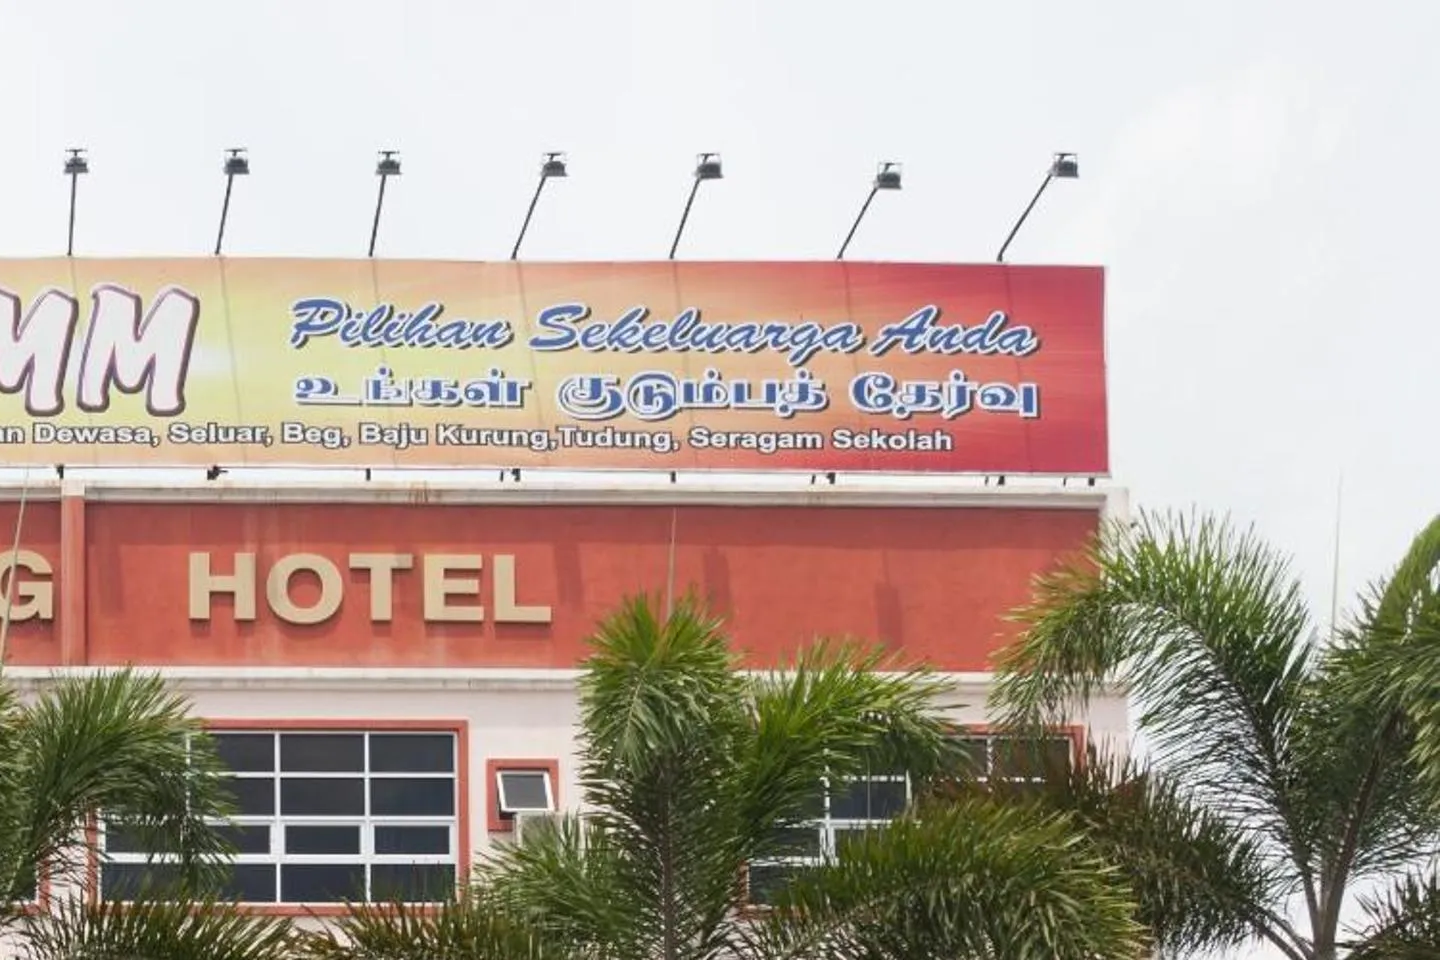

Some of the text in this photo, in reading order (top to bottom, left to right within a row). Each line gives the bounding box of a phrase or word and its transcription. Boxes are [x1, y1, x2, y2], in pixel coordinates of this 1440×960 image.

[290, 297, 1040, 367] Pilihan Sekeluarga Anda
[32, 422, 160, 448] Dewasa,
[168, 422, 273, 447] Seluar,
[281, 423, 351, 448] Beg,
[360, 423, 428, 449] Baju
[689, 426, 823, 453] Seragam
[832, 427, 953, 452] Sekolah
[189, 552, 552, 624] HOTEL
